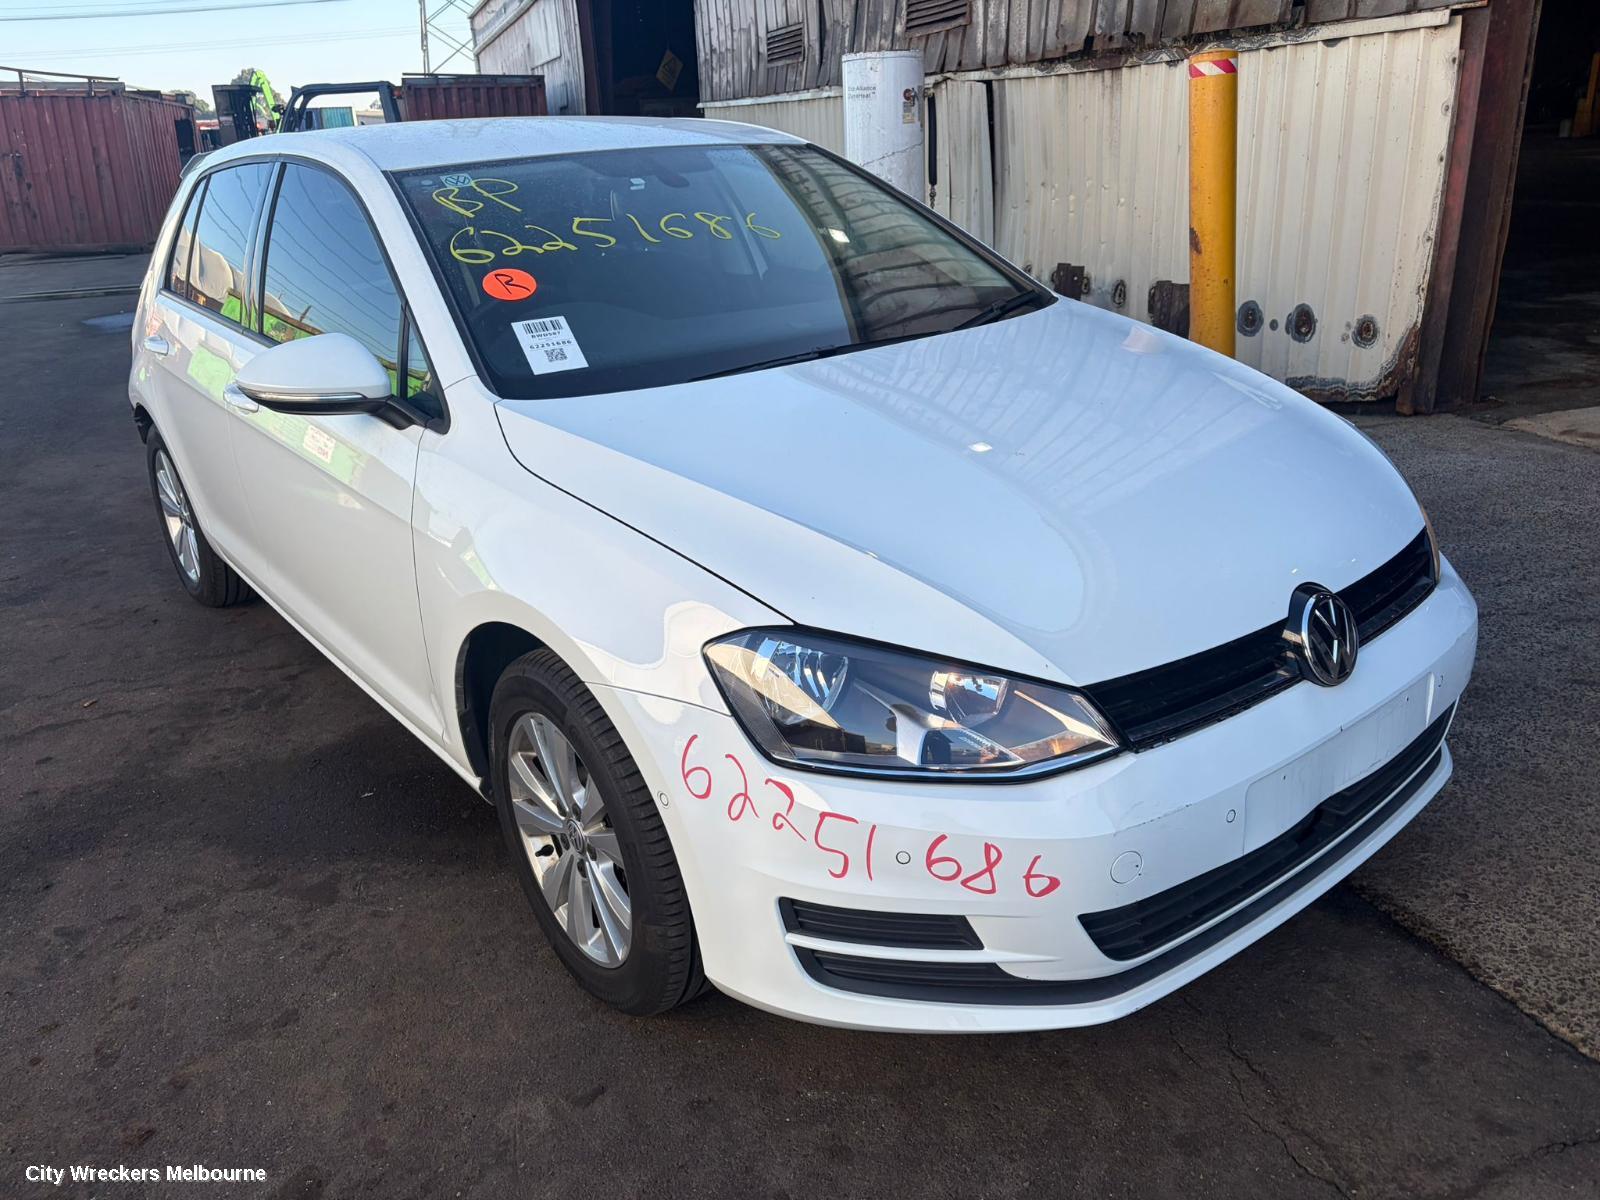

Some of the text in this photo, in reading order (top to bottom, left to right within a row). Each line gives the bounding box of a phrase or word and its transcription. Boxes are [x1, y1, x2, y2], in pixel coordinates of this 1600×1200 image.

[449, 211, 781, 265] 62251686
[493, 272, 531, 295] R
[529, 340, 572, 349] 62251686
